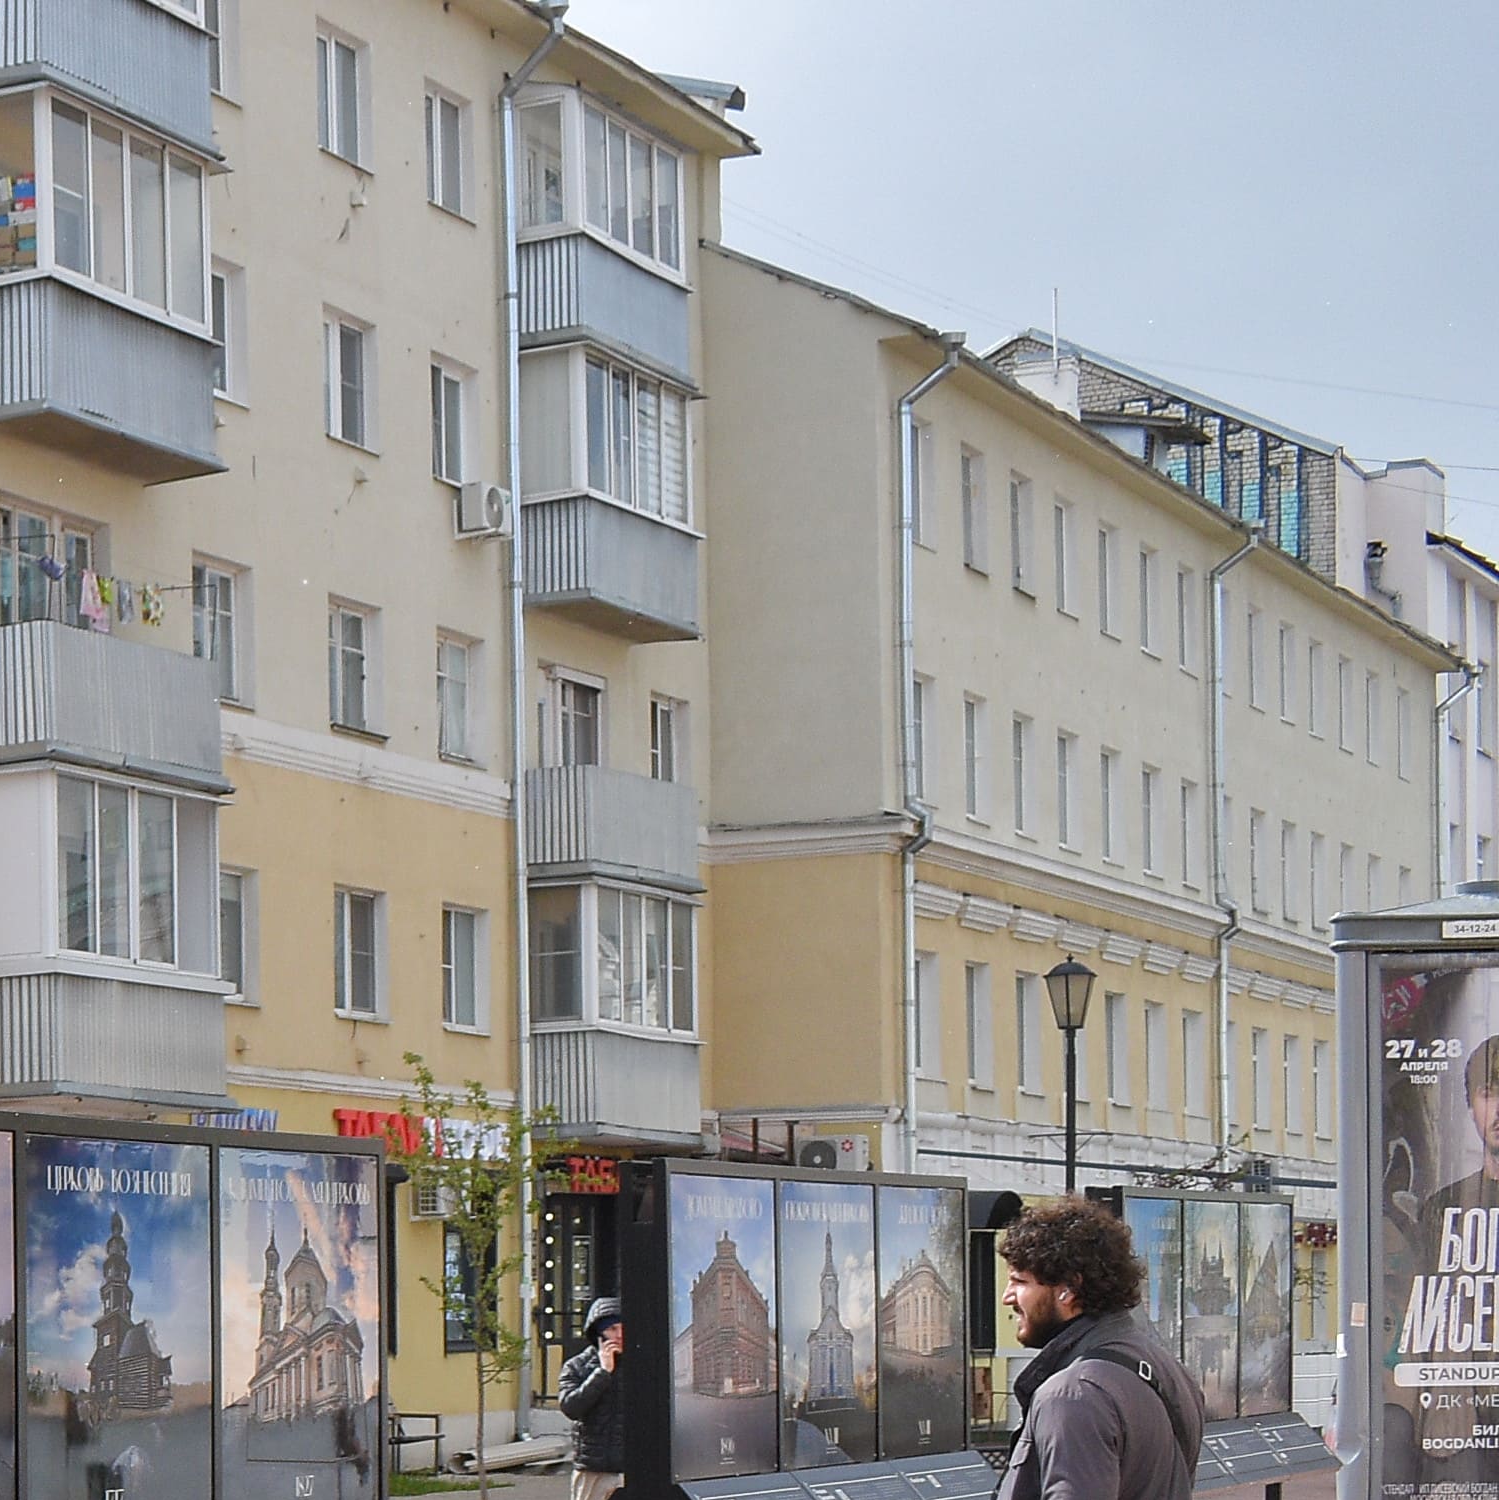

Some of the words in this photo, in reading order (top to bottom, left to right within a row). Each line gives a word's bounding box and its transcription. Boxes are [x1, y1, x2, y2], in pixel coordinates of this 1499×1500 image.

[1453, 924, 1497, 933] 34-12-24
[1385, 1039, 1415, 1058] 27
[1418, 1048, 1428, 1058] и
[1430, 1039, 1462, 1058] 28
[1400, 1062, 1449, 1071] АПРЕЛЯ
[1409, 1075, 1438, 1084] 18:00
[47, 1164, 104, 1196] ЦЕРКОВЬ
[111, 1168, 192, 1197] ВОЗНЕСЕНИЯ
[1436, 1394, 1461, 1410] ДК
